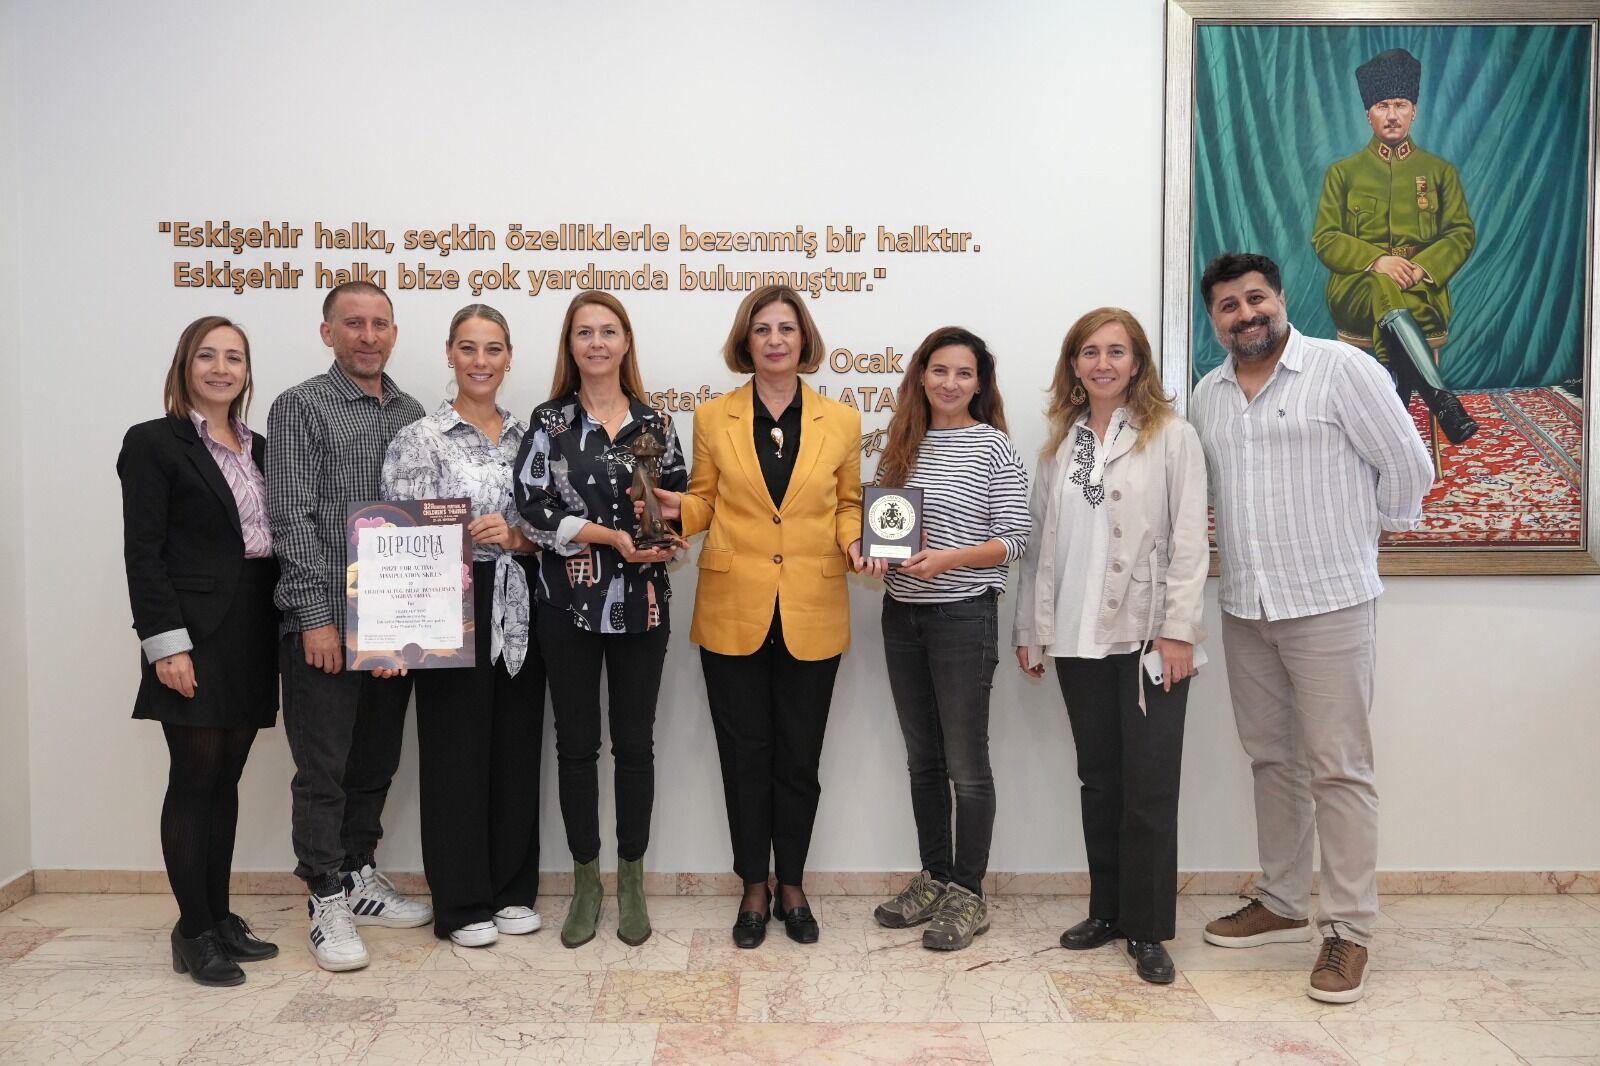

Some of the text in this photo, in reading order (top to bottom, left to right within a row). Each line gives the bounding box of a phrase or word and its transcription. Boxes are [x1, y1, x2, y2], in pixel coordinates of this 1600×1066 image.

[158, 221, 981, 258] "Eskişehir halkı, seçkin özelliklerle bezenmiş bir halktır.
[174, 260, 887, 298] Eskişehir halkı bize çok yardımda bulunmuştur."
[829, 346, 904, 374] Ocak
[376, 533, 445, 561] DIPLOMA
